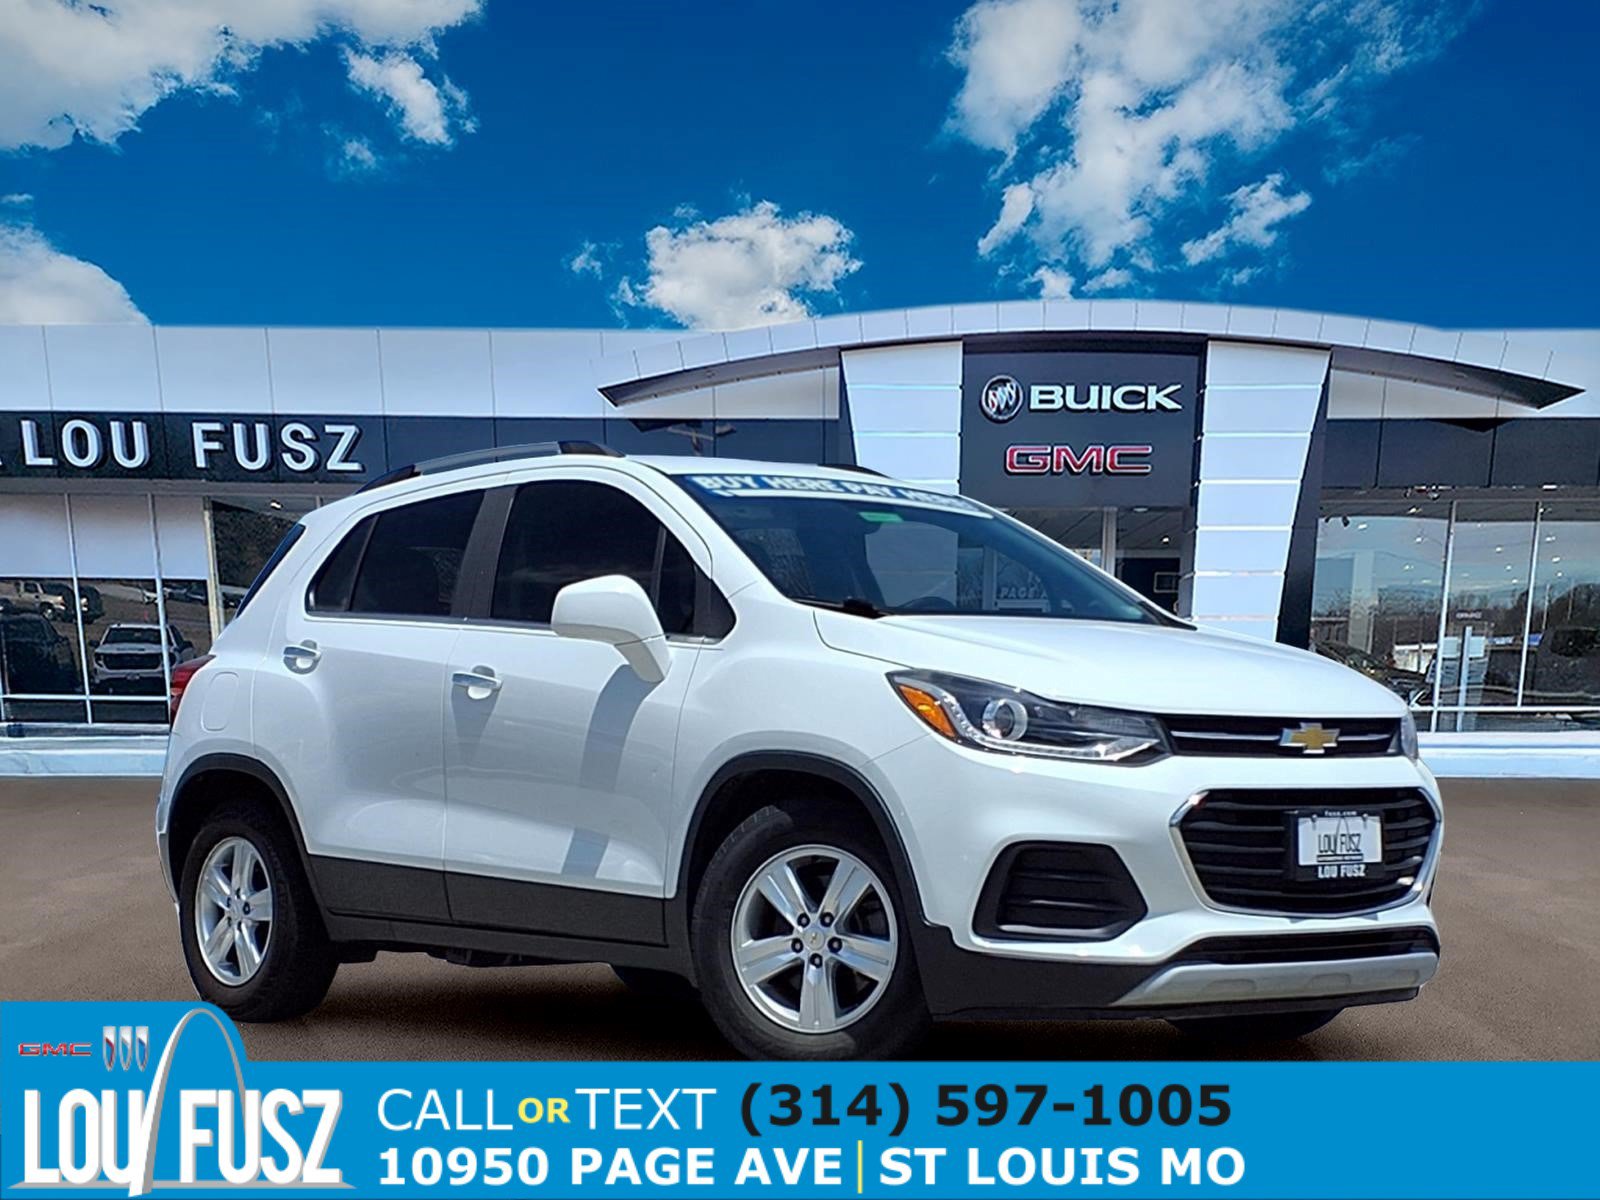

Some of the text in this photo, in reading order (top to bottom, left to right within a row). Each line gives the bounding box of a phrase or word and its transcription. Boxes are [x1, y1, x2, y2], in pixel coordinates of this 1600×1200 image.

[1029, 385, 1183, 411] BUICK
[21, 419, 364, 473] LOU FUSZ
[1005, 444, 1154, 474] GMC
[691, 475, 759, 490] BUY
[760, 476, 845, 494] HERE
[840, 481, 899, 499] PAY
[1317, 833, 1362, 855] LOU FUSZ
[1317, 864, 1366, 879] LOU FUSZ
